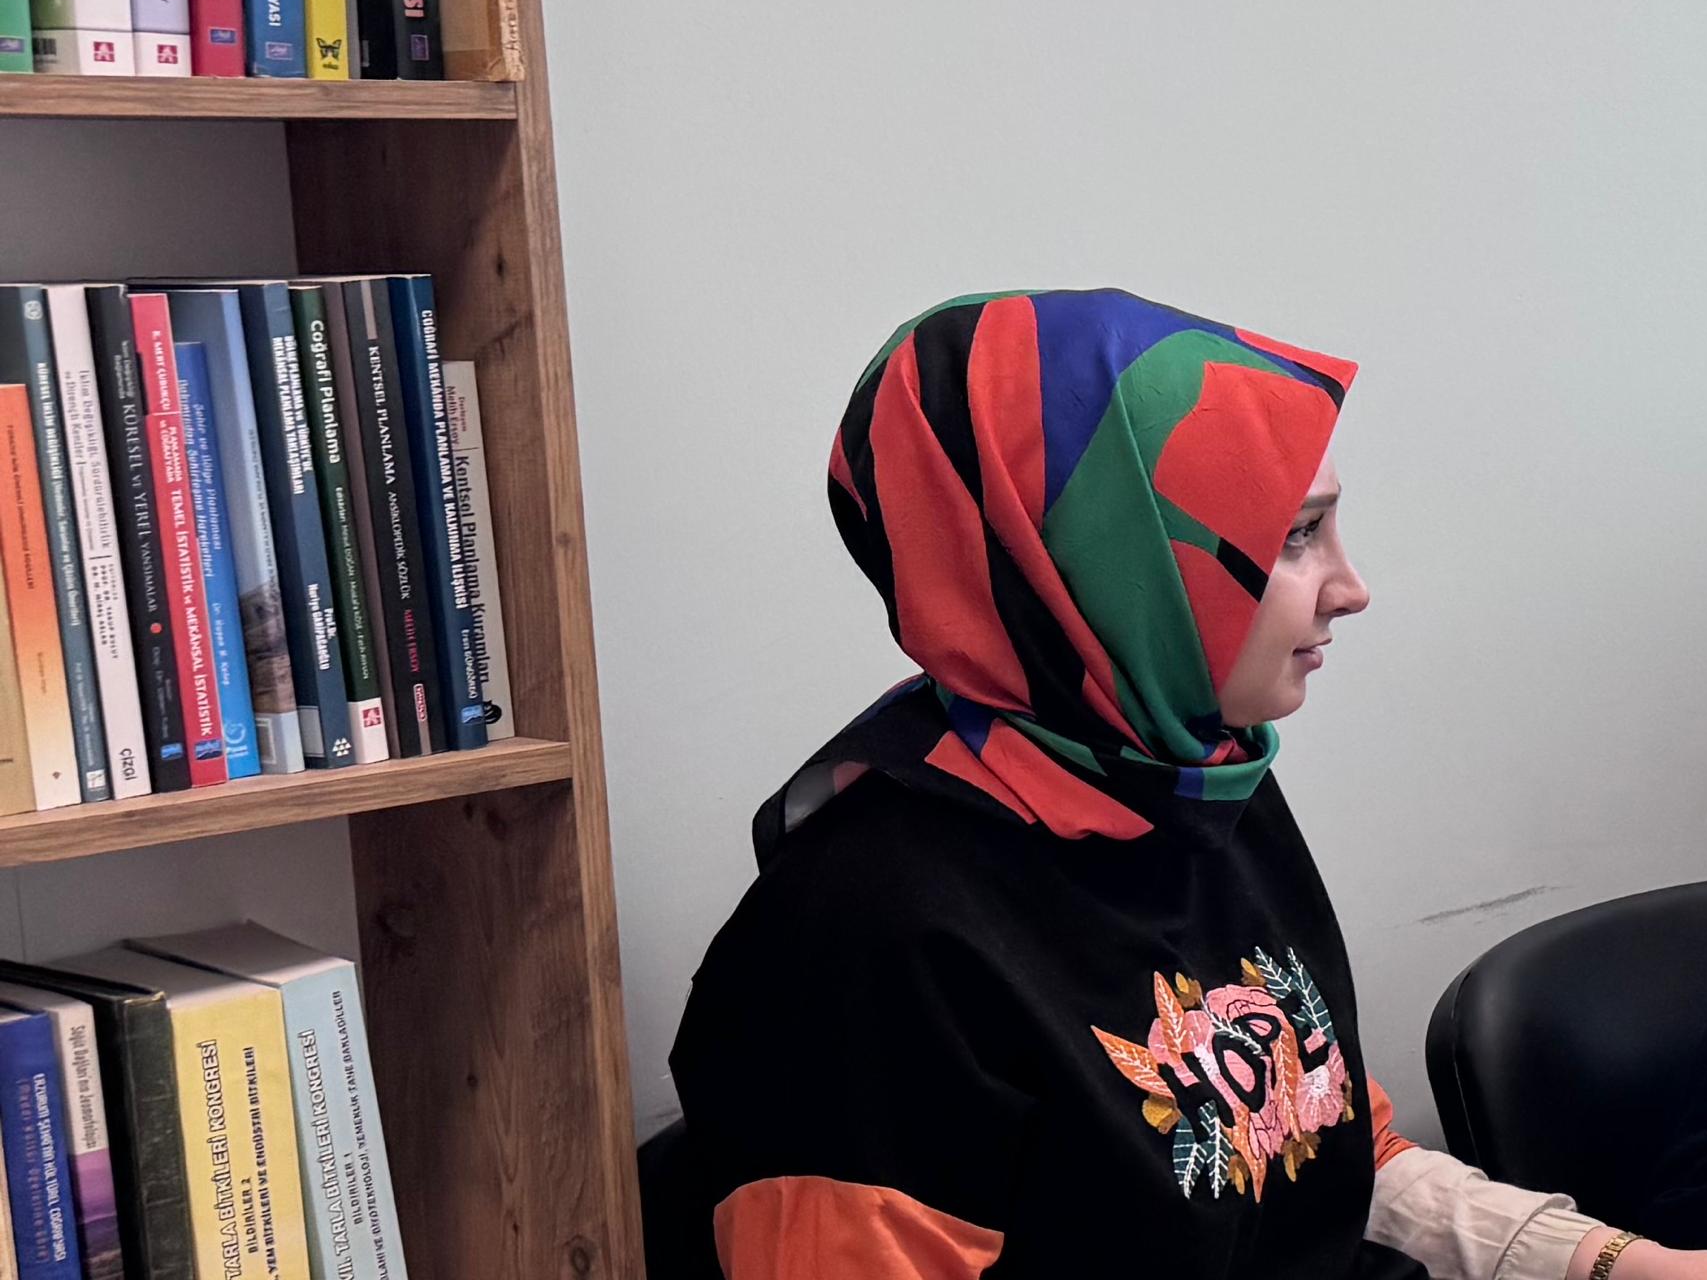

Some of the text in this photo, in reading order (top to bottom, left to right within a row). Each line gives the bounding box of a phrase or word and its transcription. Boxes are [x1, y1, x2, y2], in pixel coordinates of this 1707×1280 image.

[421, 310, 440, 359] COĞRAFİ
[288, 363, 303, 408] PLANLAMA
[310, 320, 342, 464] Coğrafi Planlama
[279, 385, 305, 494] PLANLAMA YAKLAŞIMLARI
[433, 421, 453, 482] PLANLAMA
[368, 346, 385, 406] KENTSEL
[377, 409, 396, 485] PLANLAMA
[397, 561, 411, 600] SÖZLÜK
[442, 486, 455, 500] VE
[122, 404, 144, 471] KÜRESEL
[141, 541, 157, 613] YANSIMALAR
[169, 489, 187, 528] TEMEL
[444, 503, 464, 562] KALKINMA
[175, 531, 195, 593] İSTATİSTİK
[450, 564, 469, 609] İLİŞKİSİ
[455, 456, 490, 683] Kentsel Planlama Kuramları
[186, 607, 204, 672] MEKÂNSAL
[193, 674, 214, 736] İSTATİSTİK
[195, 1038, 227, 1132] KONGRESİ
[241, 1046, 259, 1105] BİTKİLERİ
[297, 1029, 329, 1116] KONGRESİ
[248, 1107, 267, 1167] ENDÜSTRİ
[316, 1118, 342, 1200] BİTKİLERİ
[206, 1134, 235, 1220] BİTKİLERİ
[256, 1169, 268, 1184] VE
[240, 1177, 259, 1254] BİLDİRİLER 2
[257, 1187, 274, 1246] BİTKİLERİ
[329, 1200, 351, 1256] TARLA
[219, 1222, 241, 1280] TARLA
[265, 1247, 277, 1274] YEM
